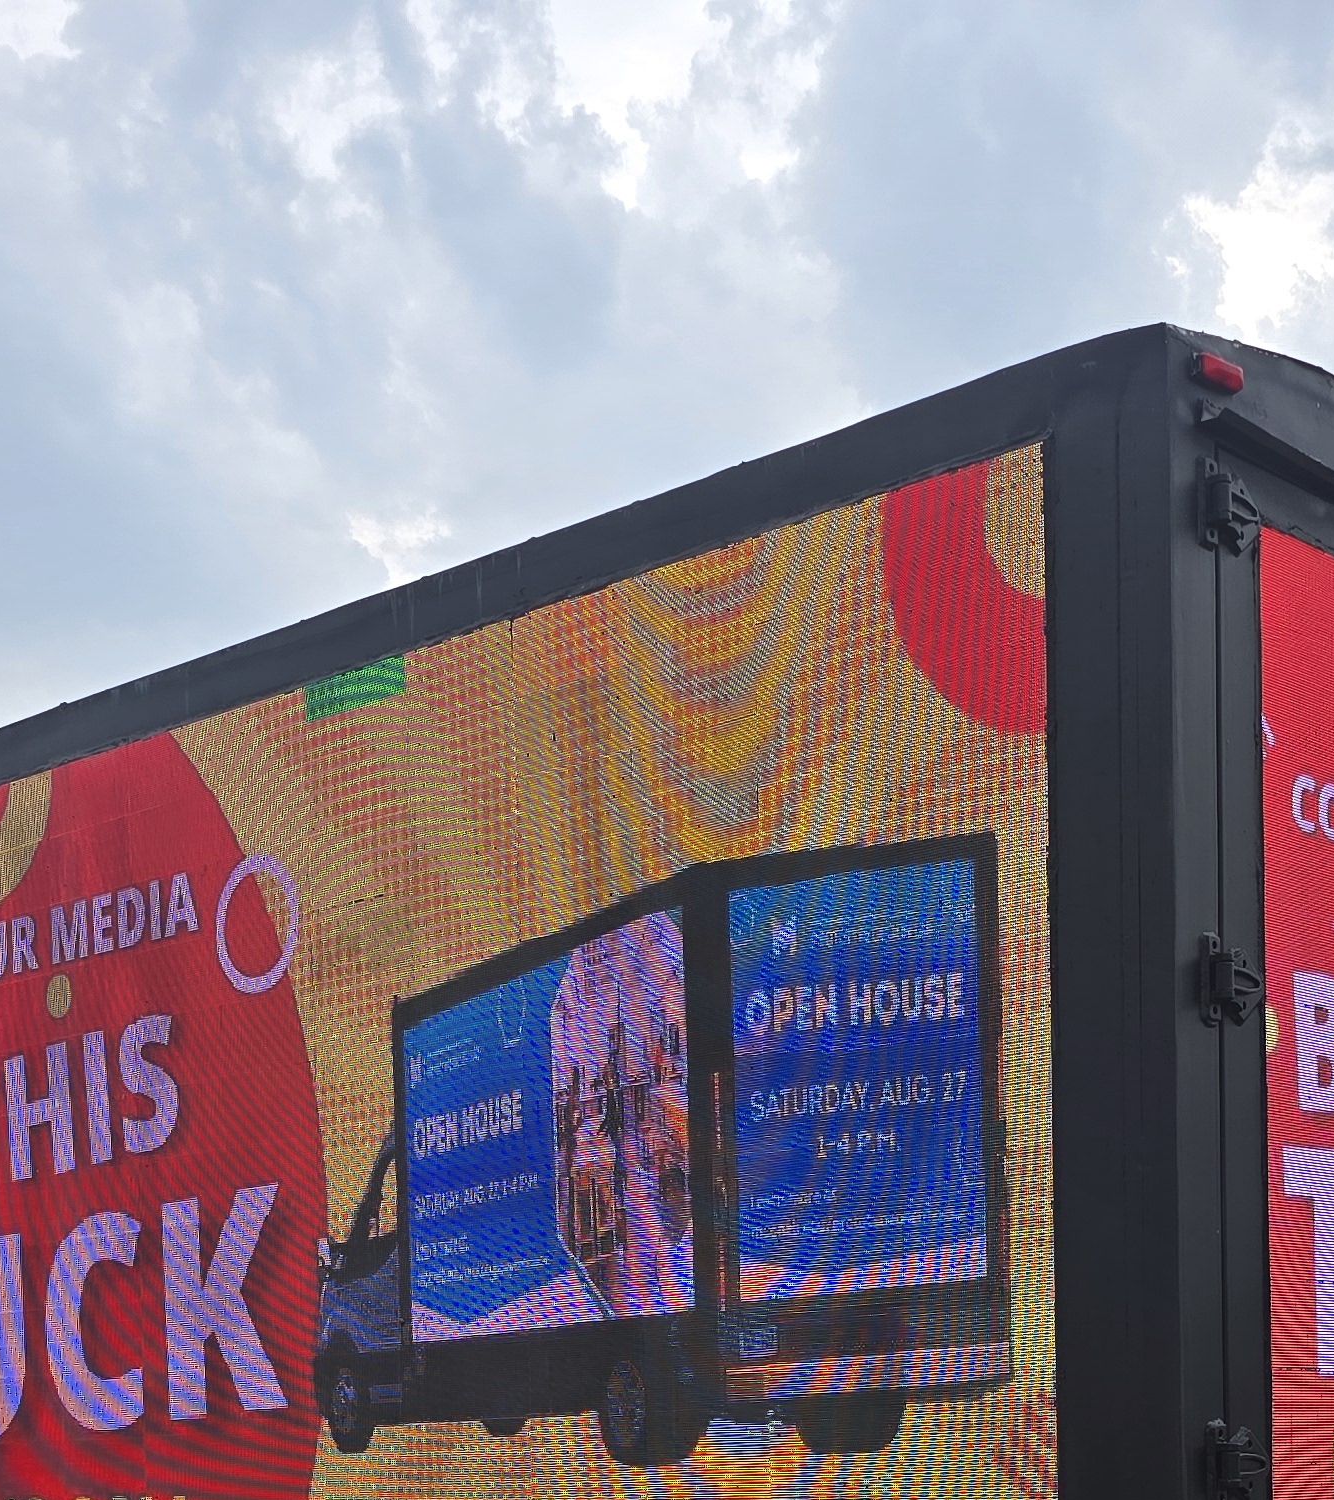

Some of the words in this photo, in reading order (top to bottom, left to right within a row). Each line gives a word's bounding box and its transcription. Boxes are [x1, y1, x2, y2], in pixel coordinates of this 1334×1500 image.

[50, 871, 200, 965] MEDIA
[745, 981, 838, 1036] OPEN
[849, 972, 965, 1027] HOUSE
[412, 1111, 458, 1160] OPEN
[462, 1088, 524, 1146] HOUSE
